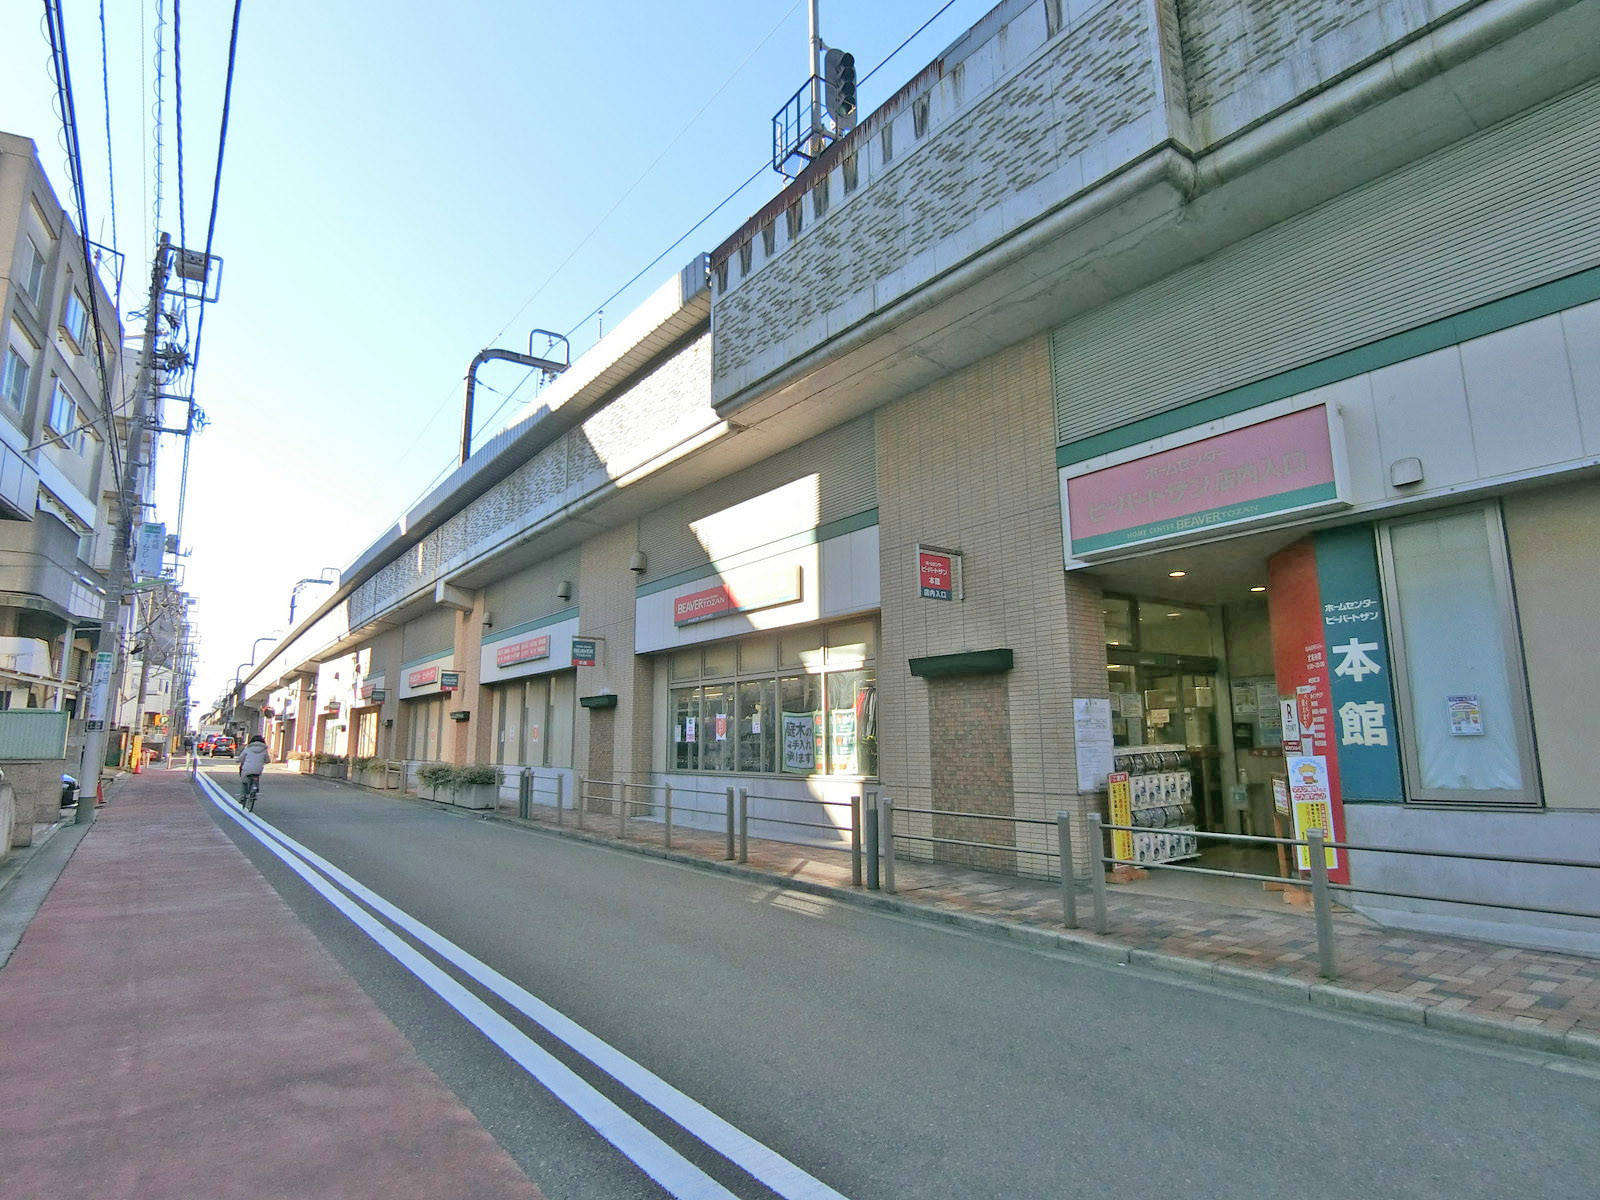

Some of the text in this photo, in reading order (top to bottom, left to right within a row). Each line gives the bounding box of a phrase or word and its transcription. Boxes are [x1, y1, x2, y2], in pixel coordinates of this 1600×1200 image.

[1324, 599, 1378, 612] ホームセンター
[1325, 611, 1378, 625] ビーバートザン
[1332, 637, 1389, 747] 本館
[786, 721, 812, 738] 庭木の
